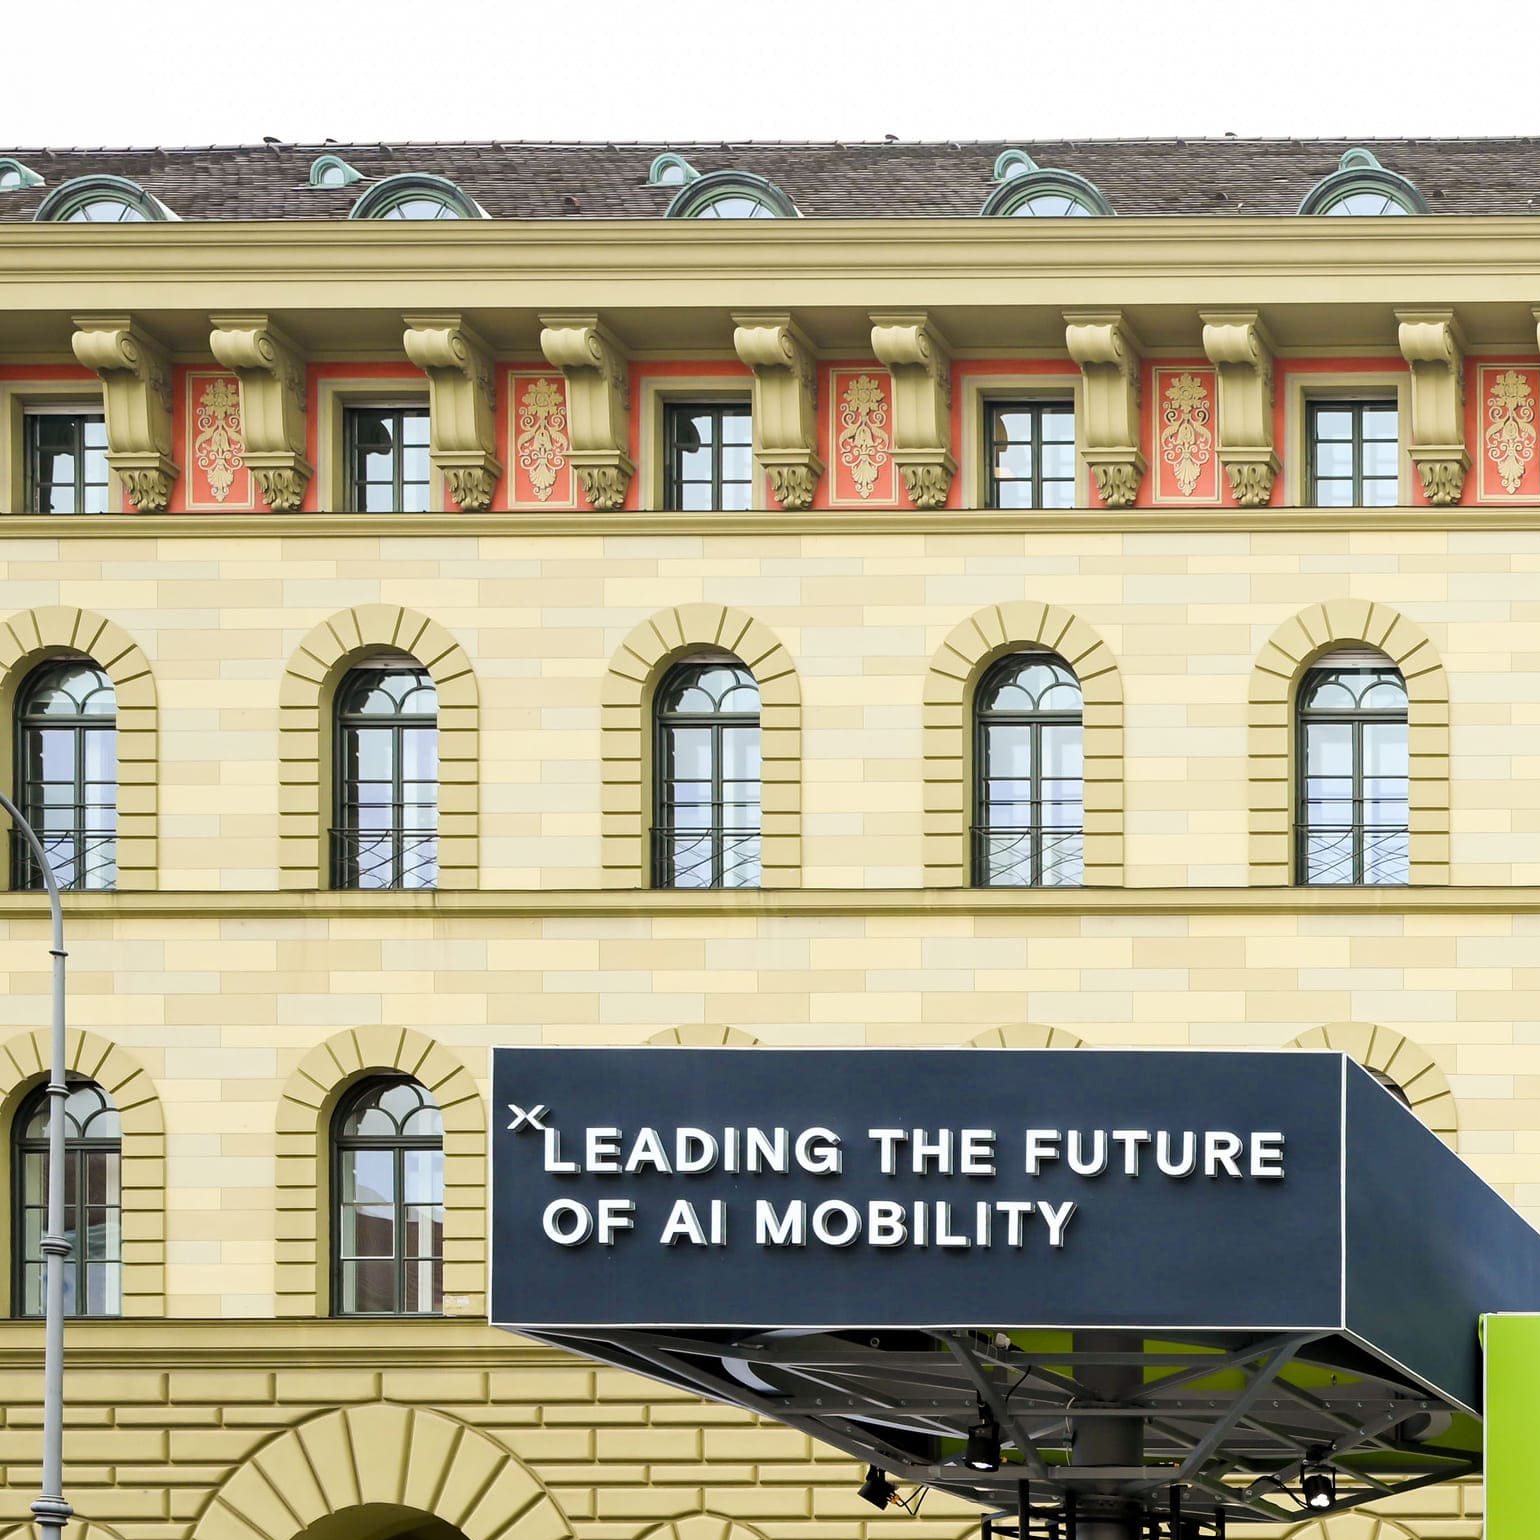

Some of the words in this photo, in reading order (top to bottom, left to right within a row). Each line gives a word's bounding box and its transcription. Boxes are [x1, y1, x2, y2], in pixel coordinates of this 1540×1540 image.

[544, 1127, 842, 1175] LEADING
[868, 1128, 996, 1176] THE
[1025, 1129, 1285, 1178] FUTURE
[543, 1199, 635, 1247] OF
[660, 1199, 727, 1247] AI
[756, 1199, 1077, 1248] MOBILITY
